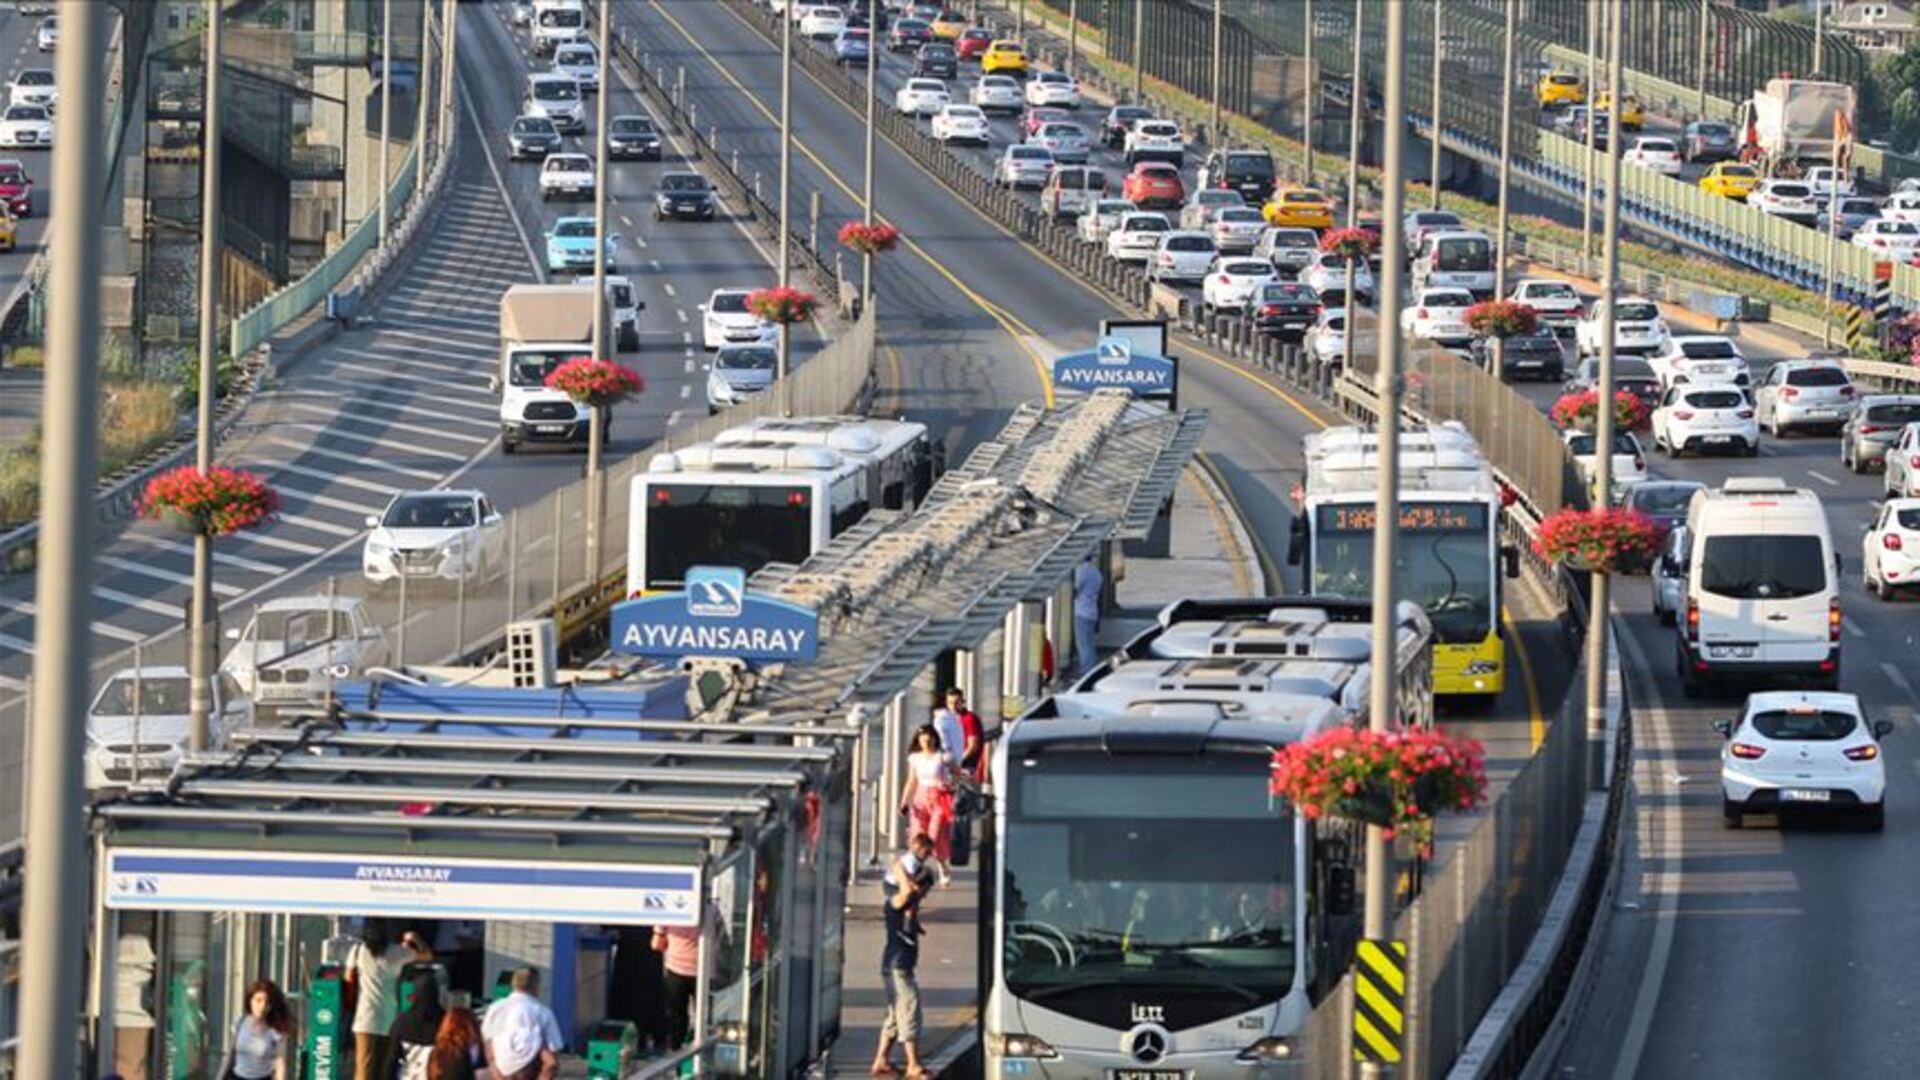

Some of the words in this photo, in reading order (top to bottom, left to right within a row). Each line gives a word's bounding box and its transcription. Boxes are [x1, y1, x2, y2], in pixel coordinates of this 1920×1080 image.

[1060, 367, 1167, 384] AYVANSARAY
[623, 623, 806, 652] AYVANSARAY
[355, 865, 452, 882] AYVANSARAY
